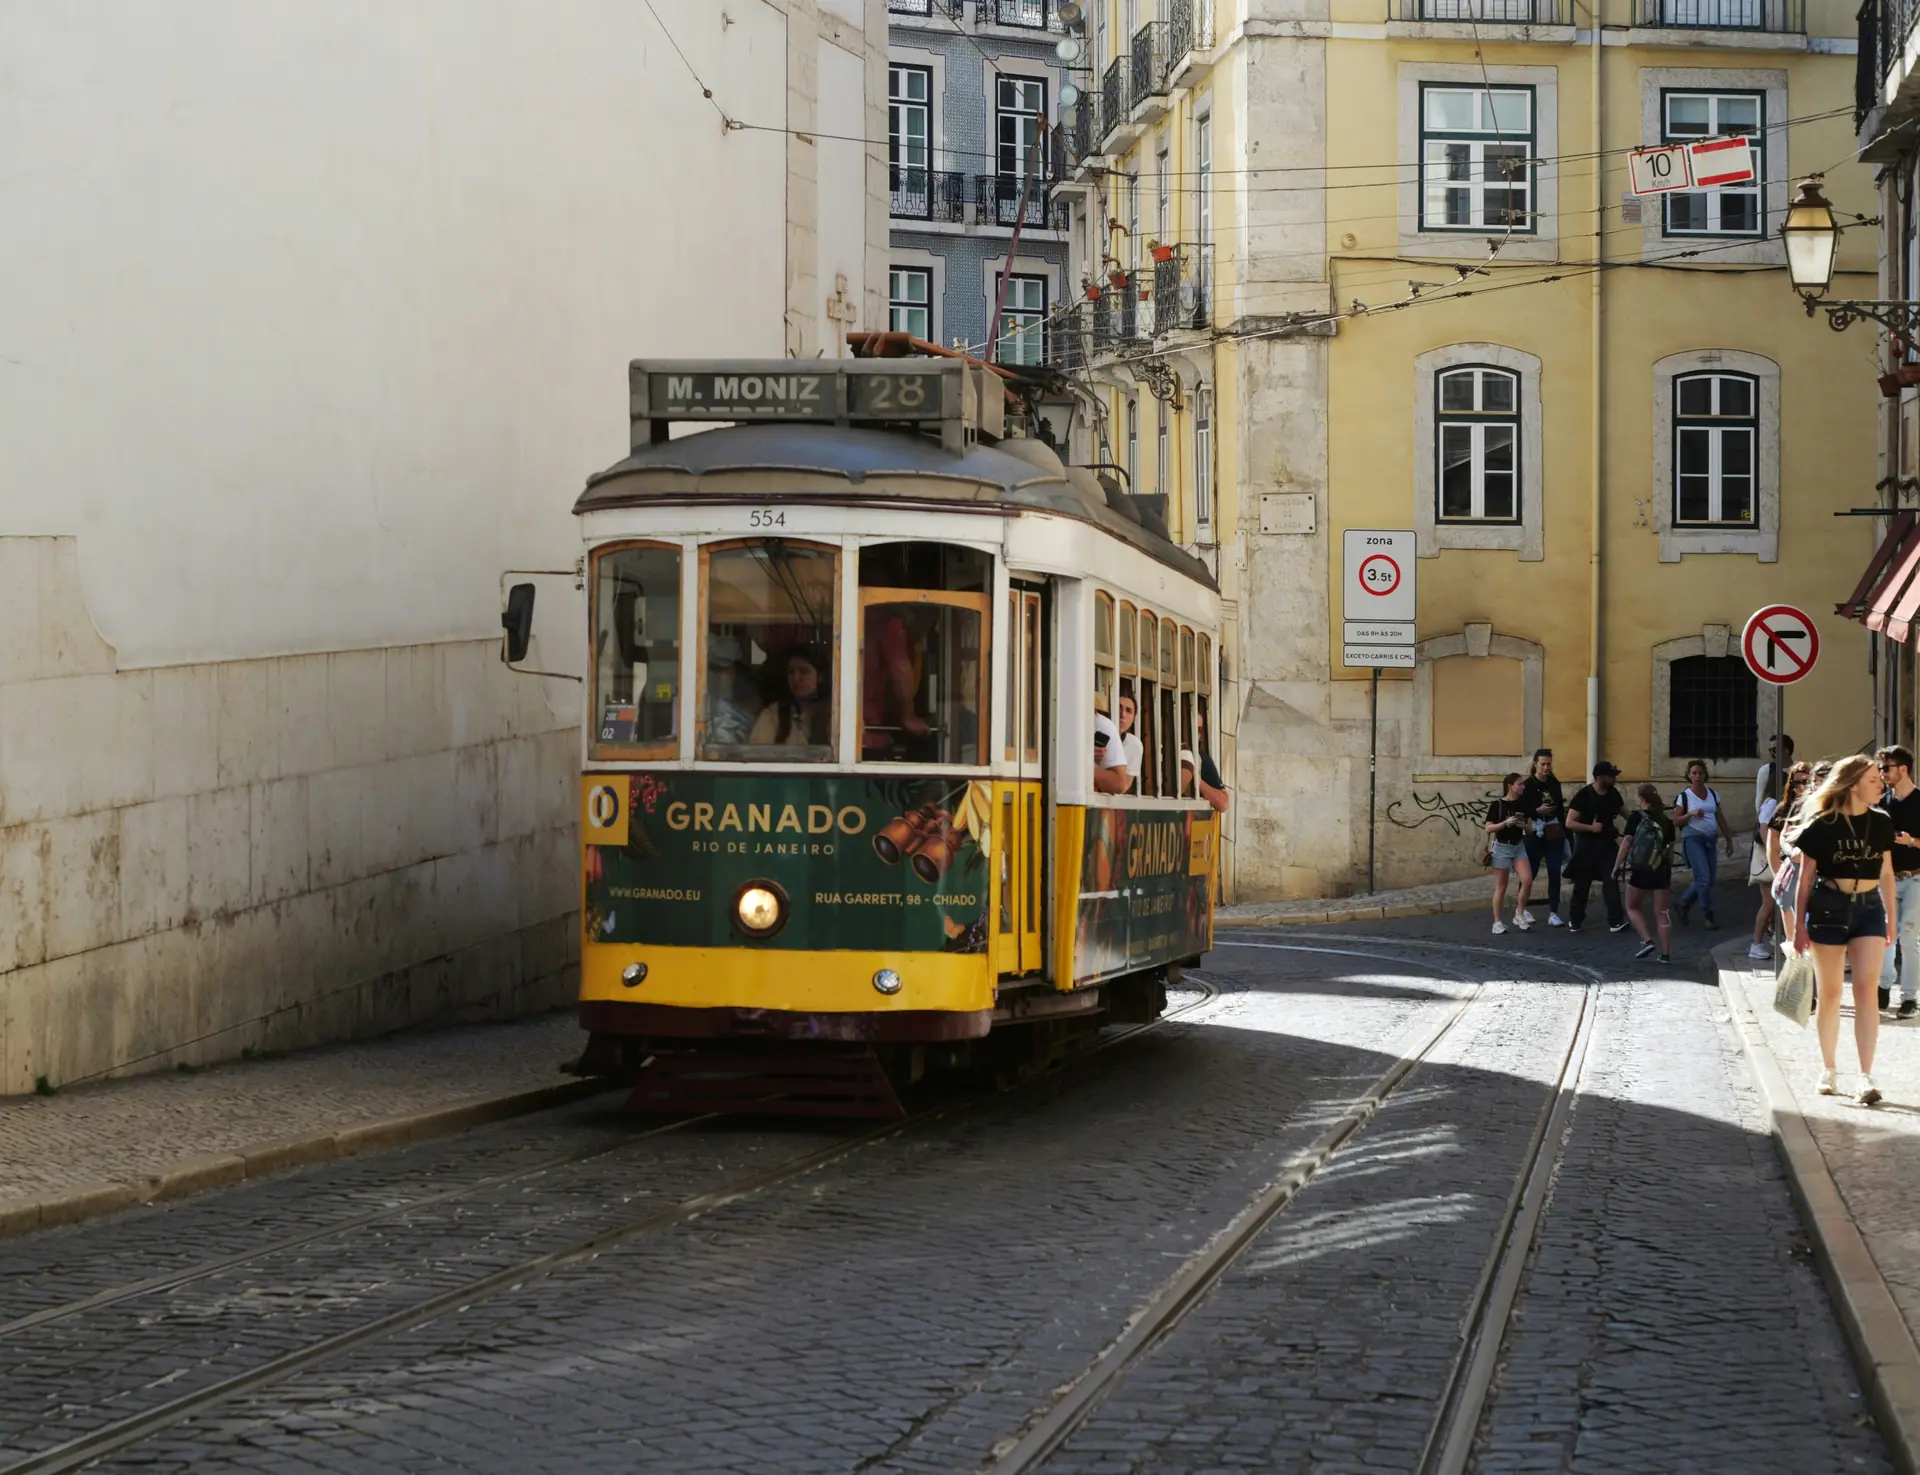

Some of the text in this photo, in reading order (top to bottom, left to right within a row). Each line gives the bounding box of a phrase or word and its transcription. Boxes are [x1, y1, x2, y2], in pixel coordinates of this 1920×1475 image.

[1646, 153, 1671, 178] 10
[1651, 178, 1671, 189] Km/h
[667, 376, 820, 400] M. MONIZ
[869, 375, 925, 409] 28
[749, 509, 787, 527] 554
[1366, 536, 1393, 546] zona
[1399, 653, 1414, 661] CML
[602, 727, 615, 740] 02
[665, 801, 868, 835] GRANADO
[692, 841, 835, 856] RIO DE JANEIRO
[1127, 822, 1184, 879] GRANADO
[815, 892, 842, 904] RUA
[844, 893, 904, 907] GARRETT,
[907, 894, 921, 905] 98
[932, 894, 977, 906] CHIADO
